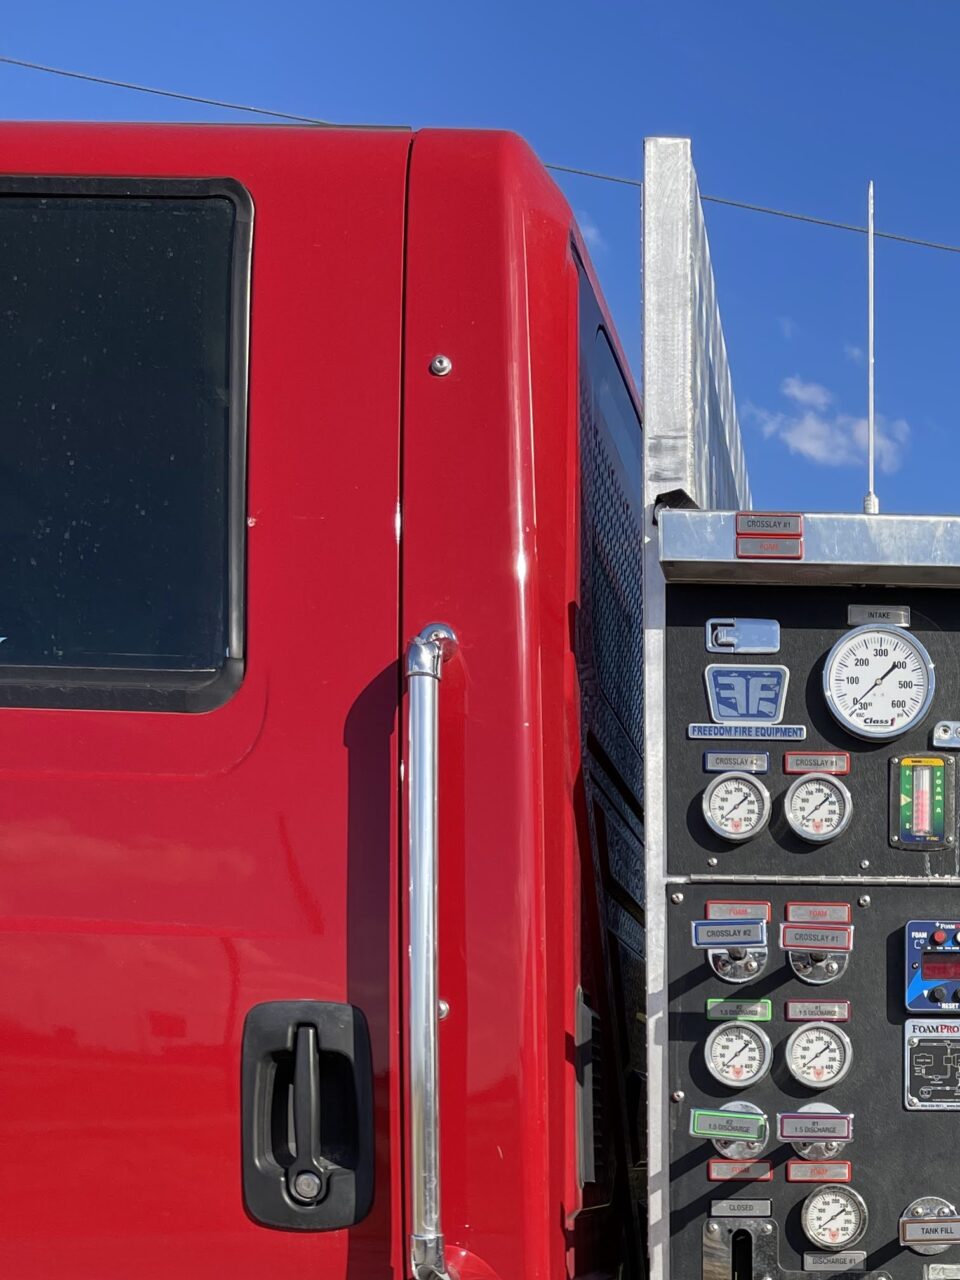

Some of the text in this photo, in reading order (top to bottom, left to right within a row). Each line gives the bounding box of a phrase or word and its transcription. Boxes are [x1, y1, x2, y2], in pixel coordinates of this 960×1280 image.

[747, 521, 781, 529] CROSSLAY
[874, 649, 888, 658] 300
[854, 658, 870, 667] 200
[893, 662, 907, 671] 400
[846, 676, 860, 685] 100
[898, 682, 914, 690] 500
[891, 700, 906, 709] 600
[692, 726, 803, 738] FREEDOM FIRE EQUIPMENT
[716, 758, 749, 766] CROSSLAY
[796, 759, 829, 768] CROSSLAY
[706, 930, 752, 940] CROSSLAY #2
[794, 932, 838, 943] CROSSLAY #1
